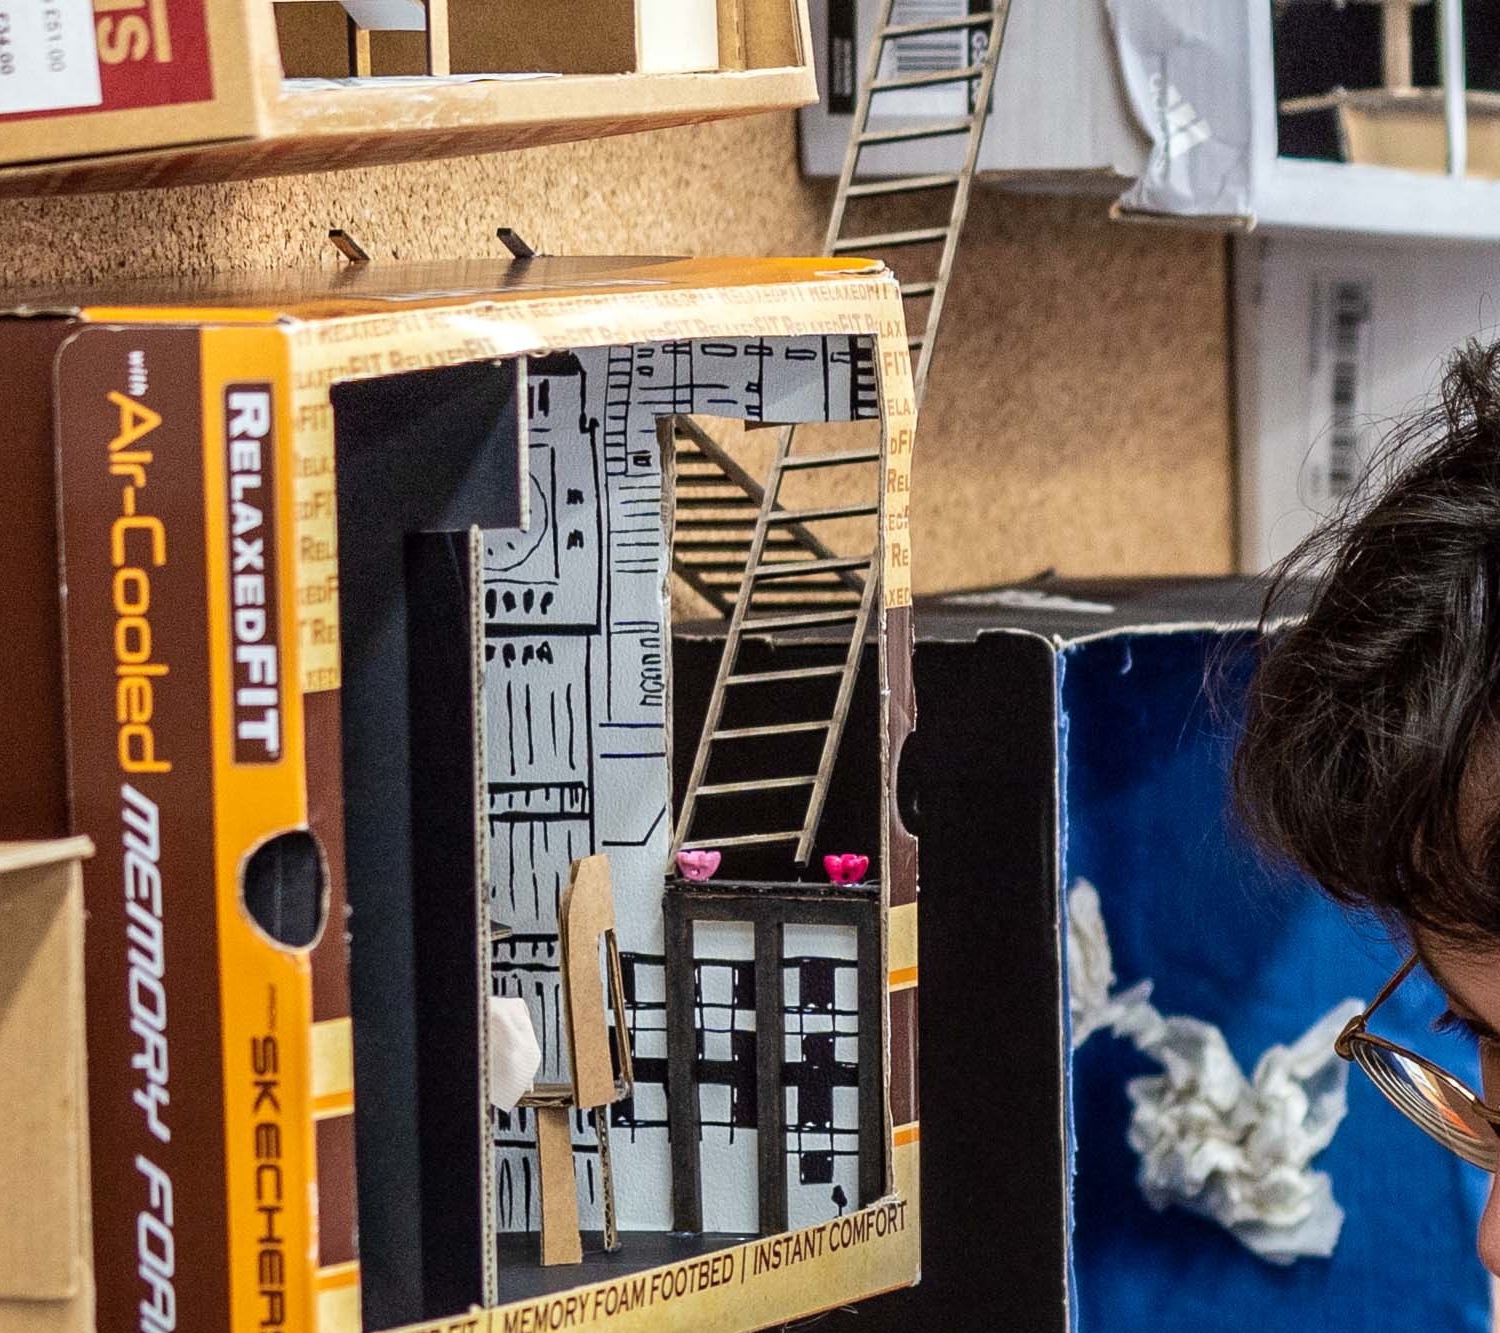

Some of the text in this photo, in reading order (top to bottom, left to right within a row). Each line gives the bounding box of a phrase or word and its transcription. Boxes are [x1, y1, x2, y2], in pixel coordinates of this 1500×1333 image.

[127, 350, 149, 396] with
[120, 782, 172, 1144] MEMORY
[591, 1281, 646, 1321] FOAM
[649, 1252, 735, 1303] FOOTBED
[752, 1226, 826, 1276] INSTANT
[827, 1199, 909, 1252] COMFORT
